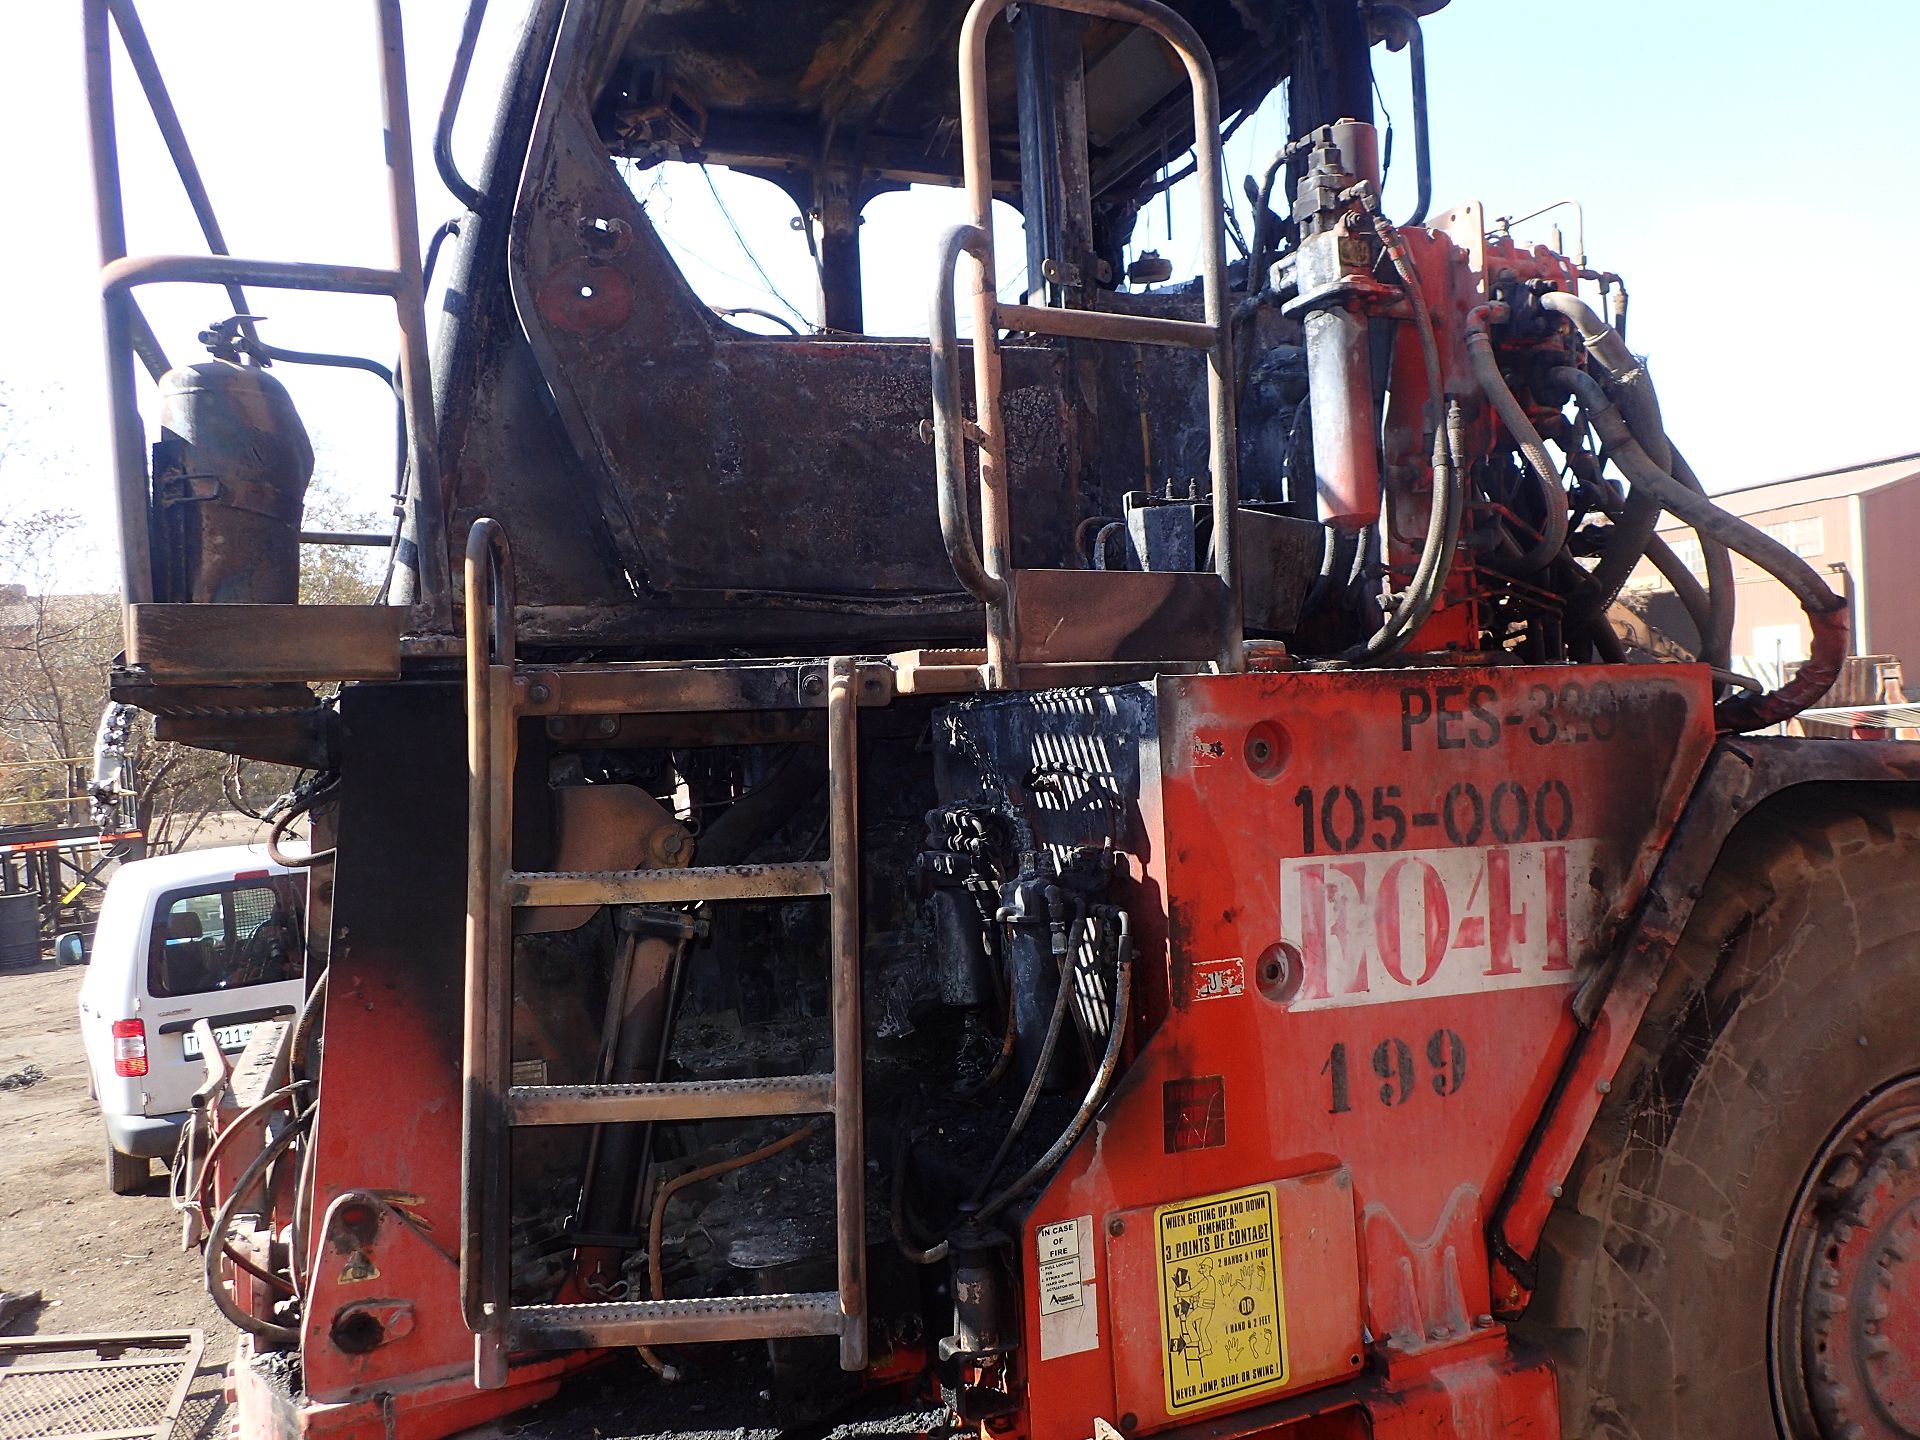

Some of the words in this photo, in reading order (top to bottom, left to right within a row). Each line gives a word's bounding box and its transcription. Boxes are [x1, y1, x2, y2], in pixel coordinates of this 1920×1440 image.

[1294, 779, 1573, 854] 105-000
[1321, 1029, 1467, 1115] 199
[1165, 1215, 1186, 1229] WHEN
[1188, 1208, 1216, 1224] GETTING
[1218, 1205, 1228, 1218] UP
[1230, 1201, 1244, 1215] AND
[1246, 1197, 1266, 1213] DOWN
[1041, 1229, 1050, 1237] IN
[1052, 1223, 1074, 1235] CASE
[1197, 1218, 1237, 1236] REMEMBER:
[1053, 1237, 1064, 1246] OF
[1165, 1245, 1171, 1260] 3
[1176, 1237, 1210, 1258] POINTS
[1214, 1233, 1225, 1250] OF
[1229, 1223, 1268, 1246] CONTACT
[1049, 1247, 1068, 1258] FIRE
[1223, 1253, 1243, 1267] HANDS
[1255, 1247, 1268, 1259] FOOT
[1240, 1298, 1253, 1313] OR
[1230, 1321, 1245, 1334] HAND
[1259, 1314, 1271, 1326] FEET
[1175, 1385, 1197, 1400] NEVER
[1221, 1373, 1239, 1388] SLIDE
[1241, 1370, 1251, 1382] OR
[1252, 1364, 1274, 1380] SWING
